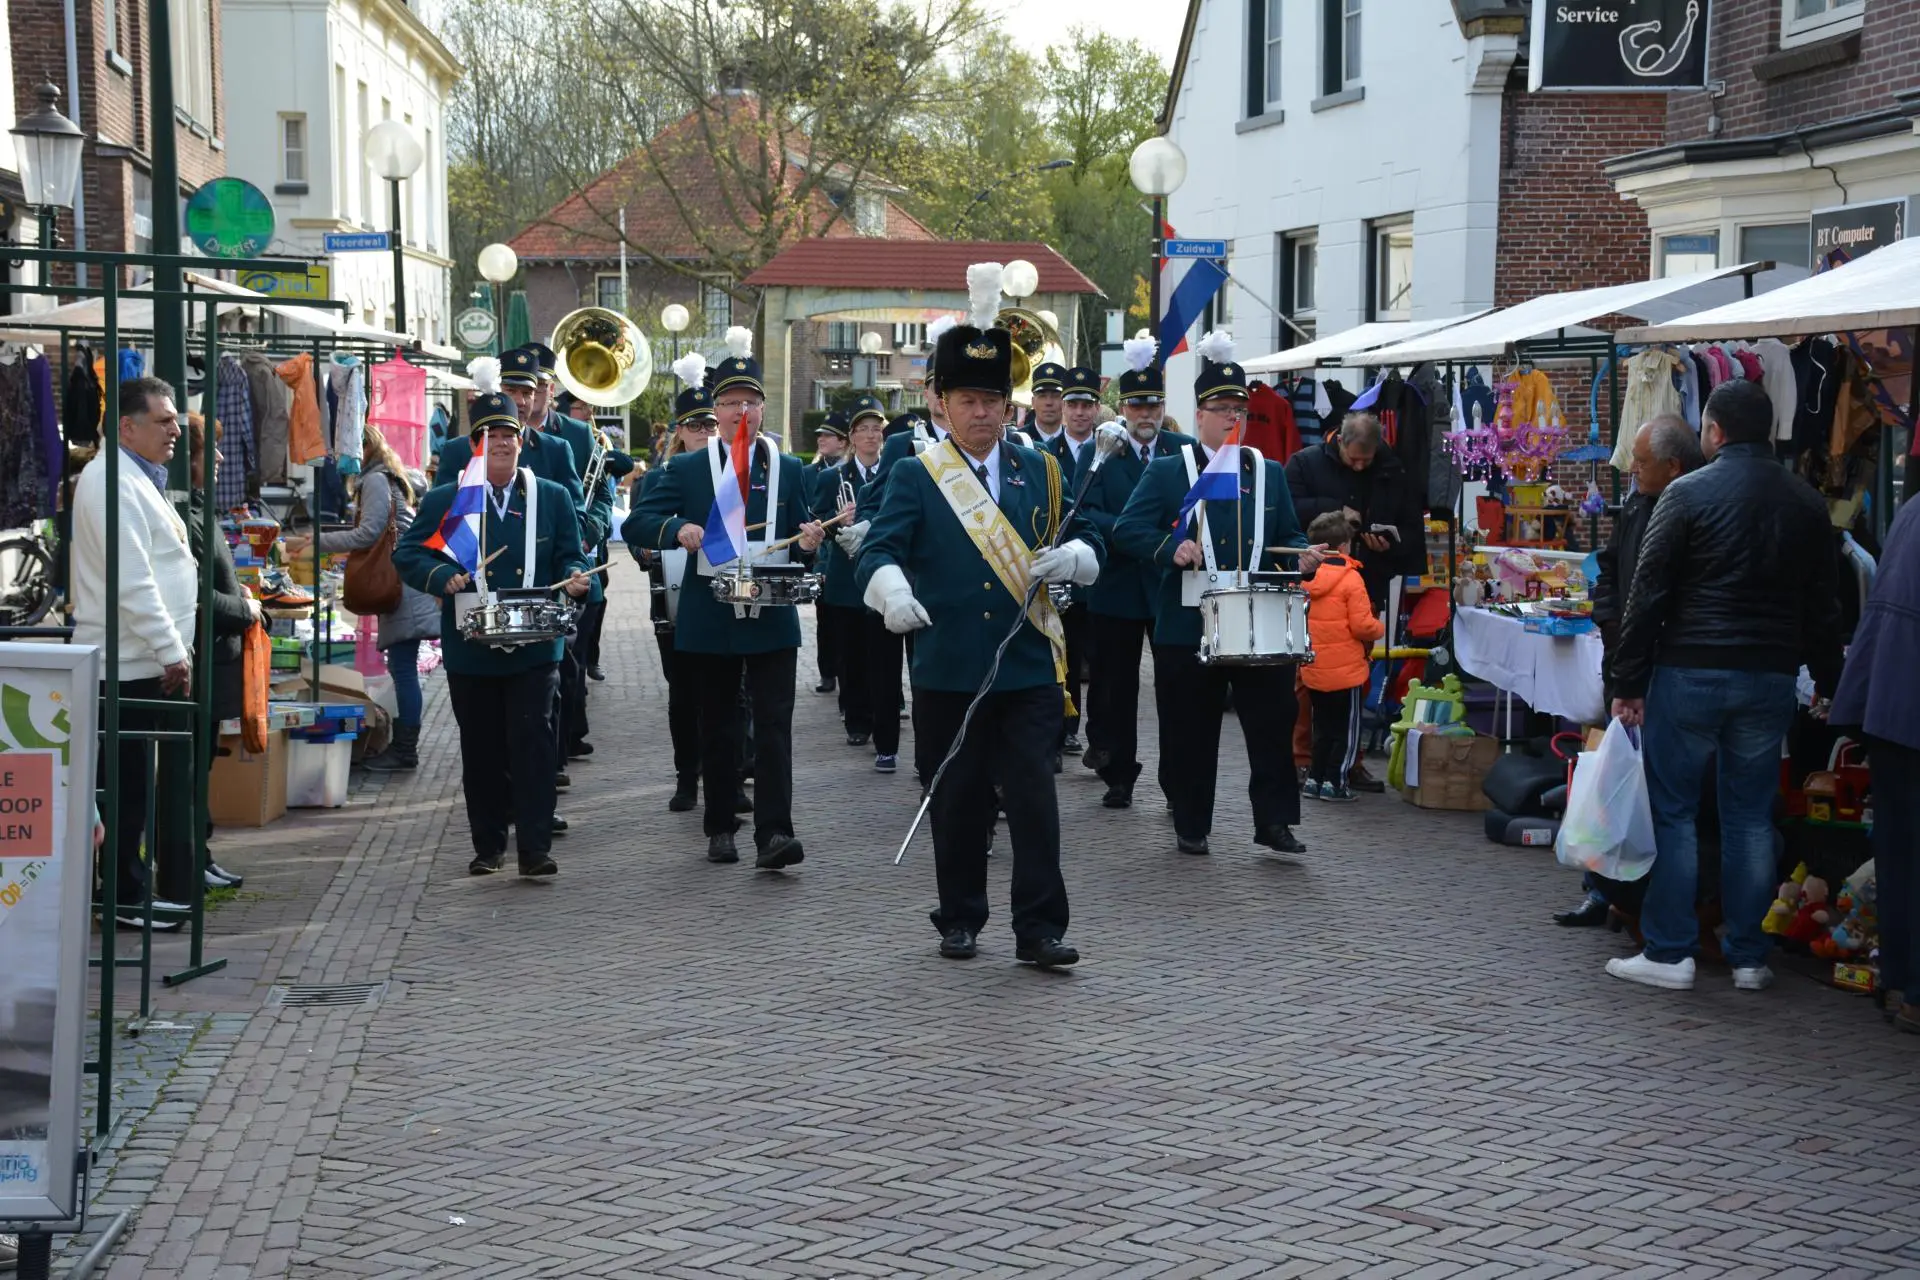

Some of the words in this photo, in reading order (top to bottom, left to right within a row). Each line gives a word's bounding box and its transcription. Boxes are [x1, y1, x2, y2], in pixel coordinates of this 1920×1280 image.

[1556, 6, 1619, 23] Service
[331, 236, 382, 248] Noordwal
[1817, 227, 1831, 247] BT
[1831, 224, 1875, 247] Computer
[1176, 243, 1216, 253] Zuidwal
